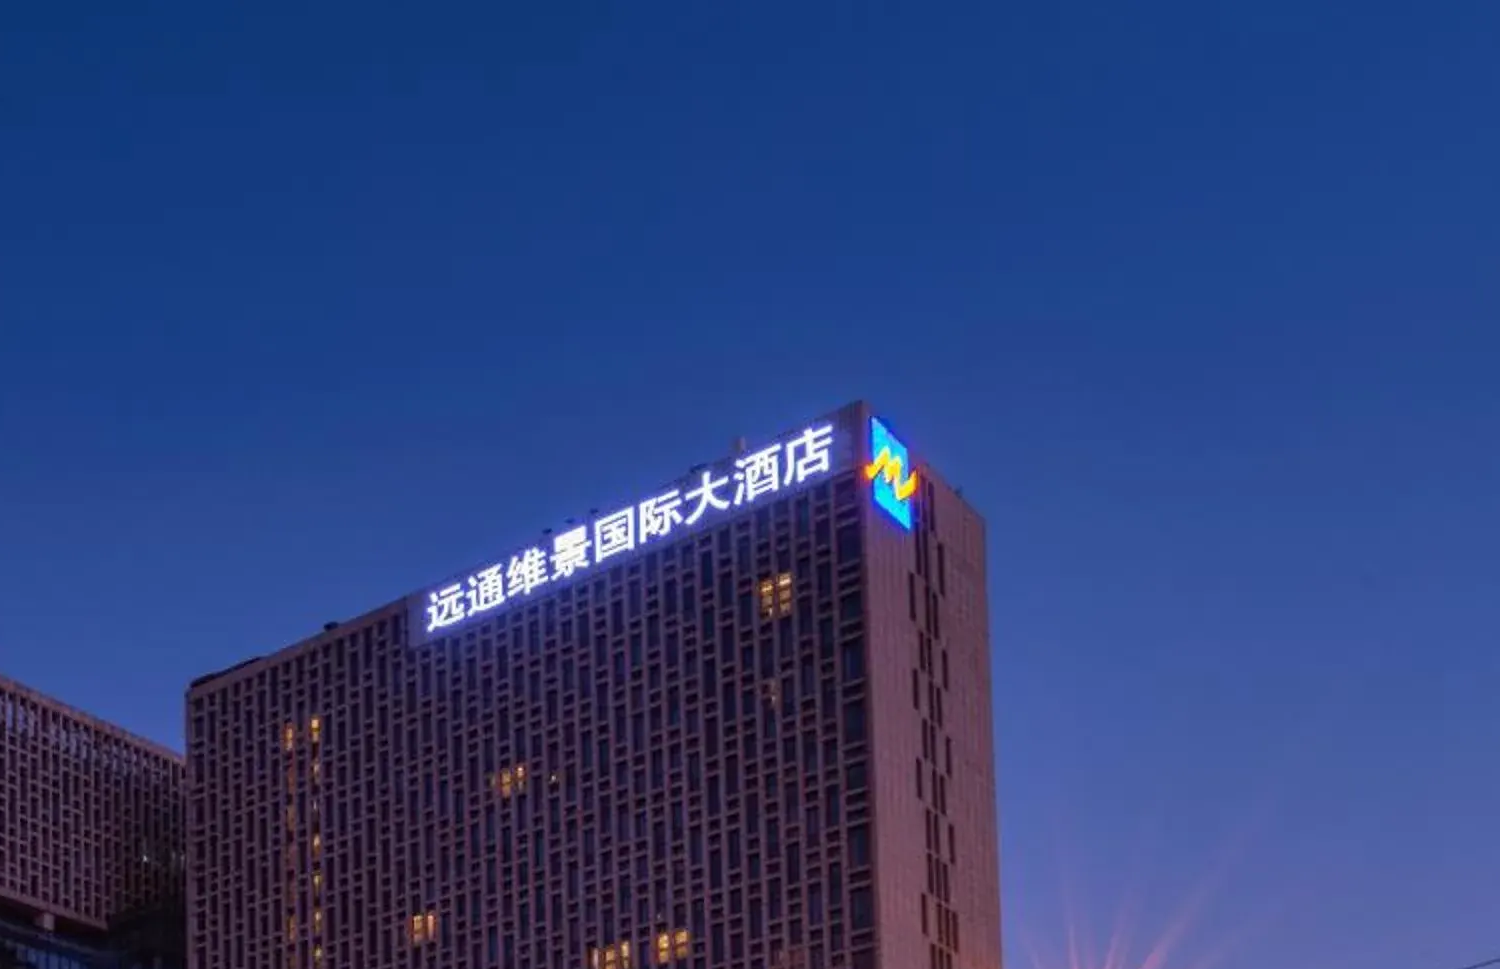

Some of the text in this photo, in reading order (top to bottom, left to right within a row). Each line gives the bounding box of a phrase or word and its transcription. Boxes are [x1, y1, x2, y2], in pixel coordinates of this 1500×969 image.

[426, 424, 834, 632] 远通维景国际大酒店
